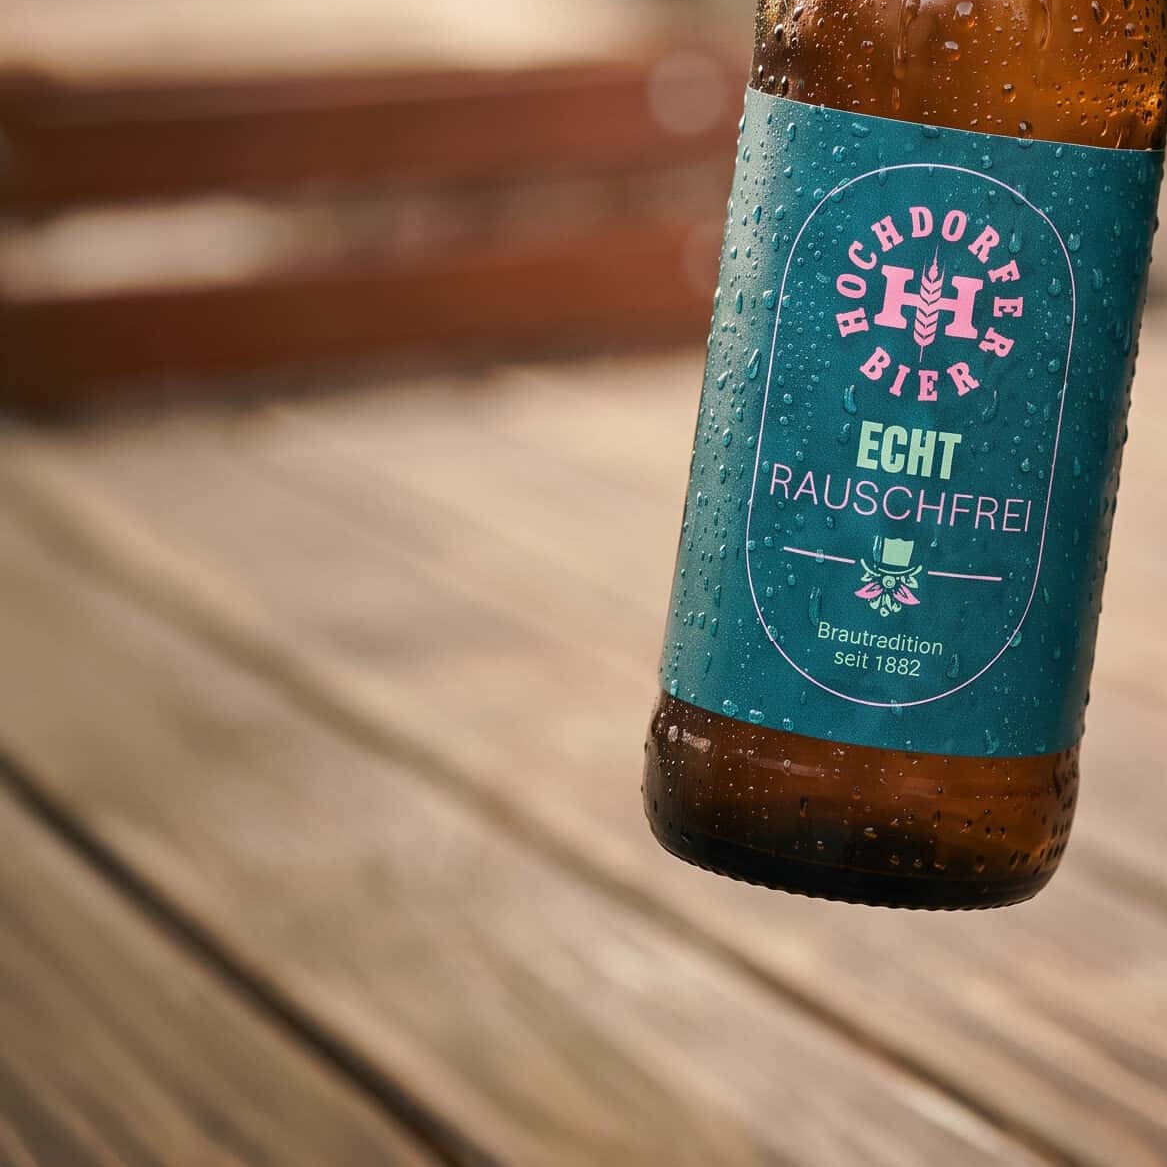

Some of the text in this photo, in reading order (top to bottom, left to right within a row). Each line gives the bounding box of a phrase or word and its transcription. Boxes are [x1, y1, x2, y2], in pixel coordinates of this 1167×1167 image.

[835, 205, 1023, 359] HOCHDORFER
[873, 264, 983, 340] H
[859, 346, 980, 402] BIER
[856, 421, 961, 479] ECHT
[768, 463, 1033, 532] RAUSCHFREI
[817, 621, 943, 655] Brautradition
[834, 649, 921, 677] seit 1882
